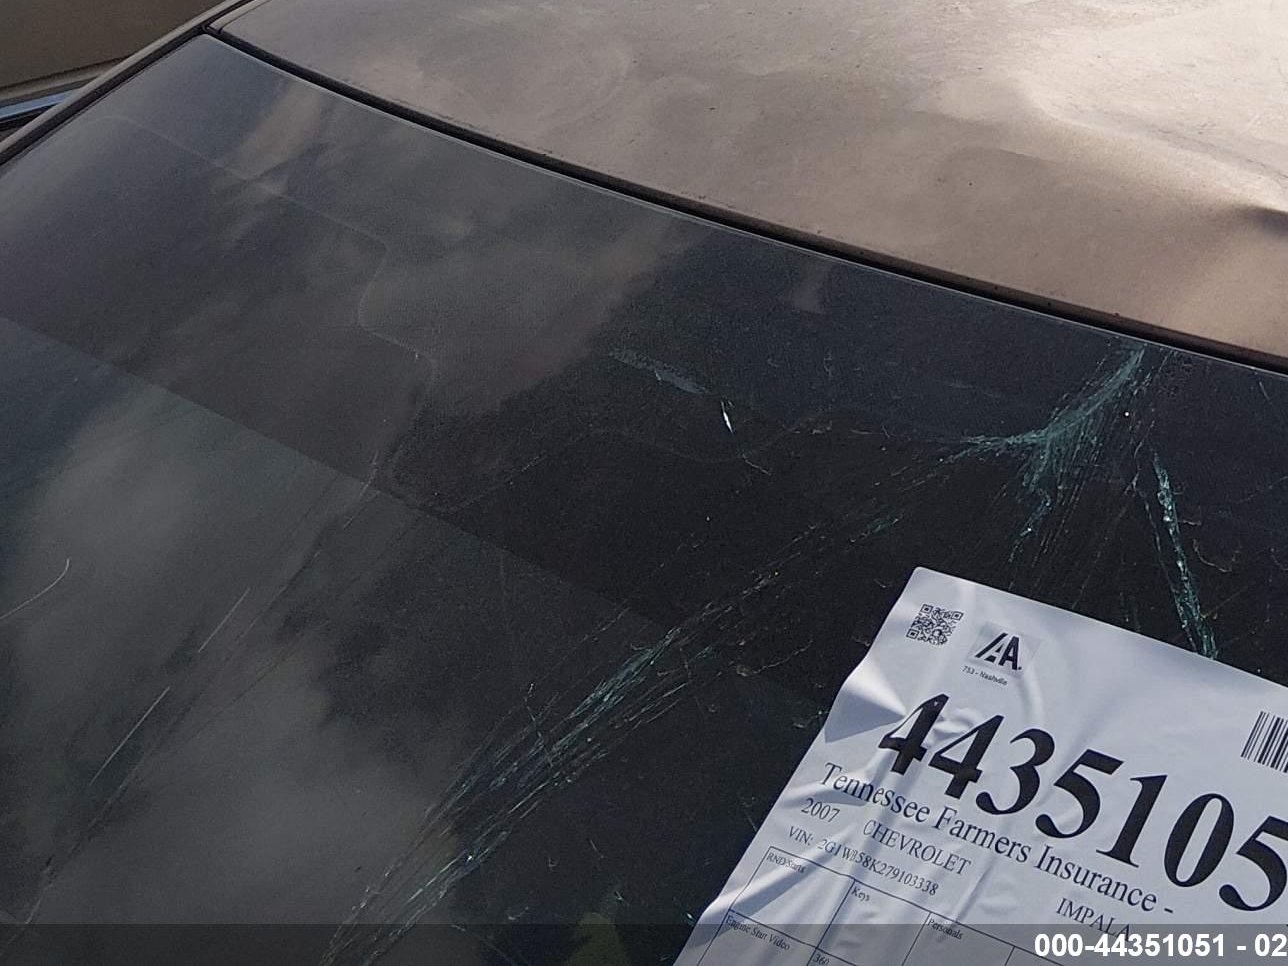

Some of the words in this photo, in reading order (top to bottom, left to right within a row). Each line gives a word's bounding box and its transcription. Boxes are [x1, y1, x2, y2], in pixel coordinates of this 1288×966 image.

[980, 671, 1008, 685] Nashville
[788, 825, 814, 847] VIN:
[800, 798, 841, 823] 2007
[863, 819, 972, 875] CHEVROLET
[820, 762, 931, 823] Tennessee
[932, 806, 1032, 863] Farmers
[1034, 844, 1158, 912] Insurance
[1164, 907, 1174, 915] -
[851, 886, 871, 902] Keys
[726, 915, 751, 934] Engine
[751, 927, 768, 940] Start
[769, 934, 790, 951] Video
[927, 918, 963, 940] Personals
